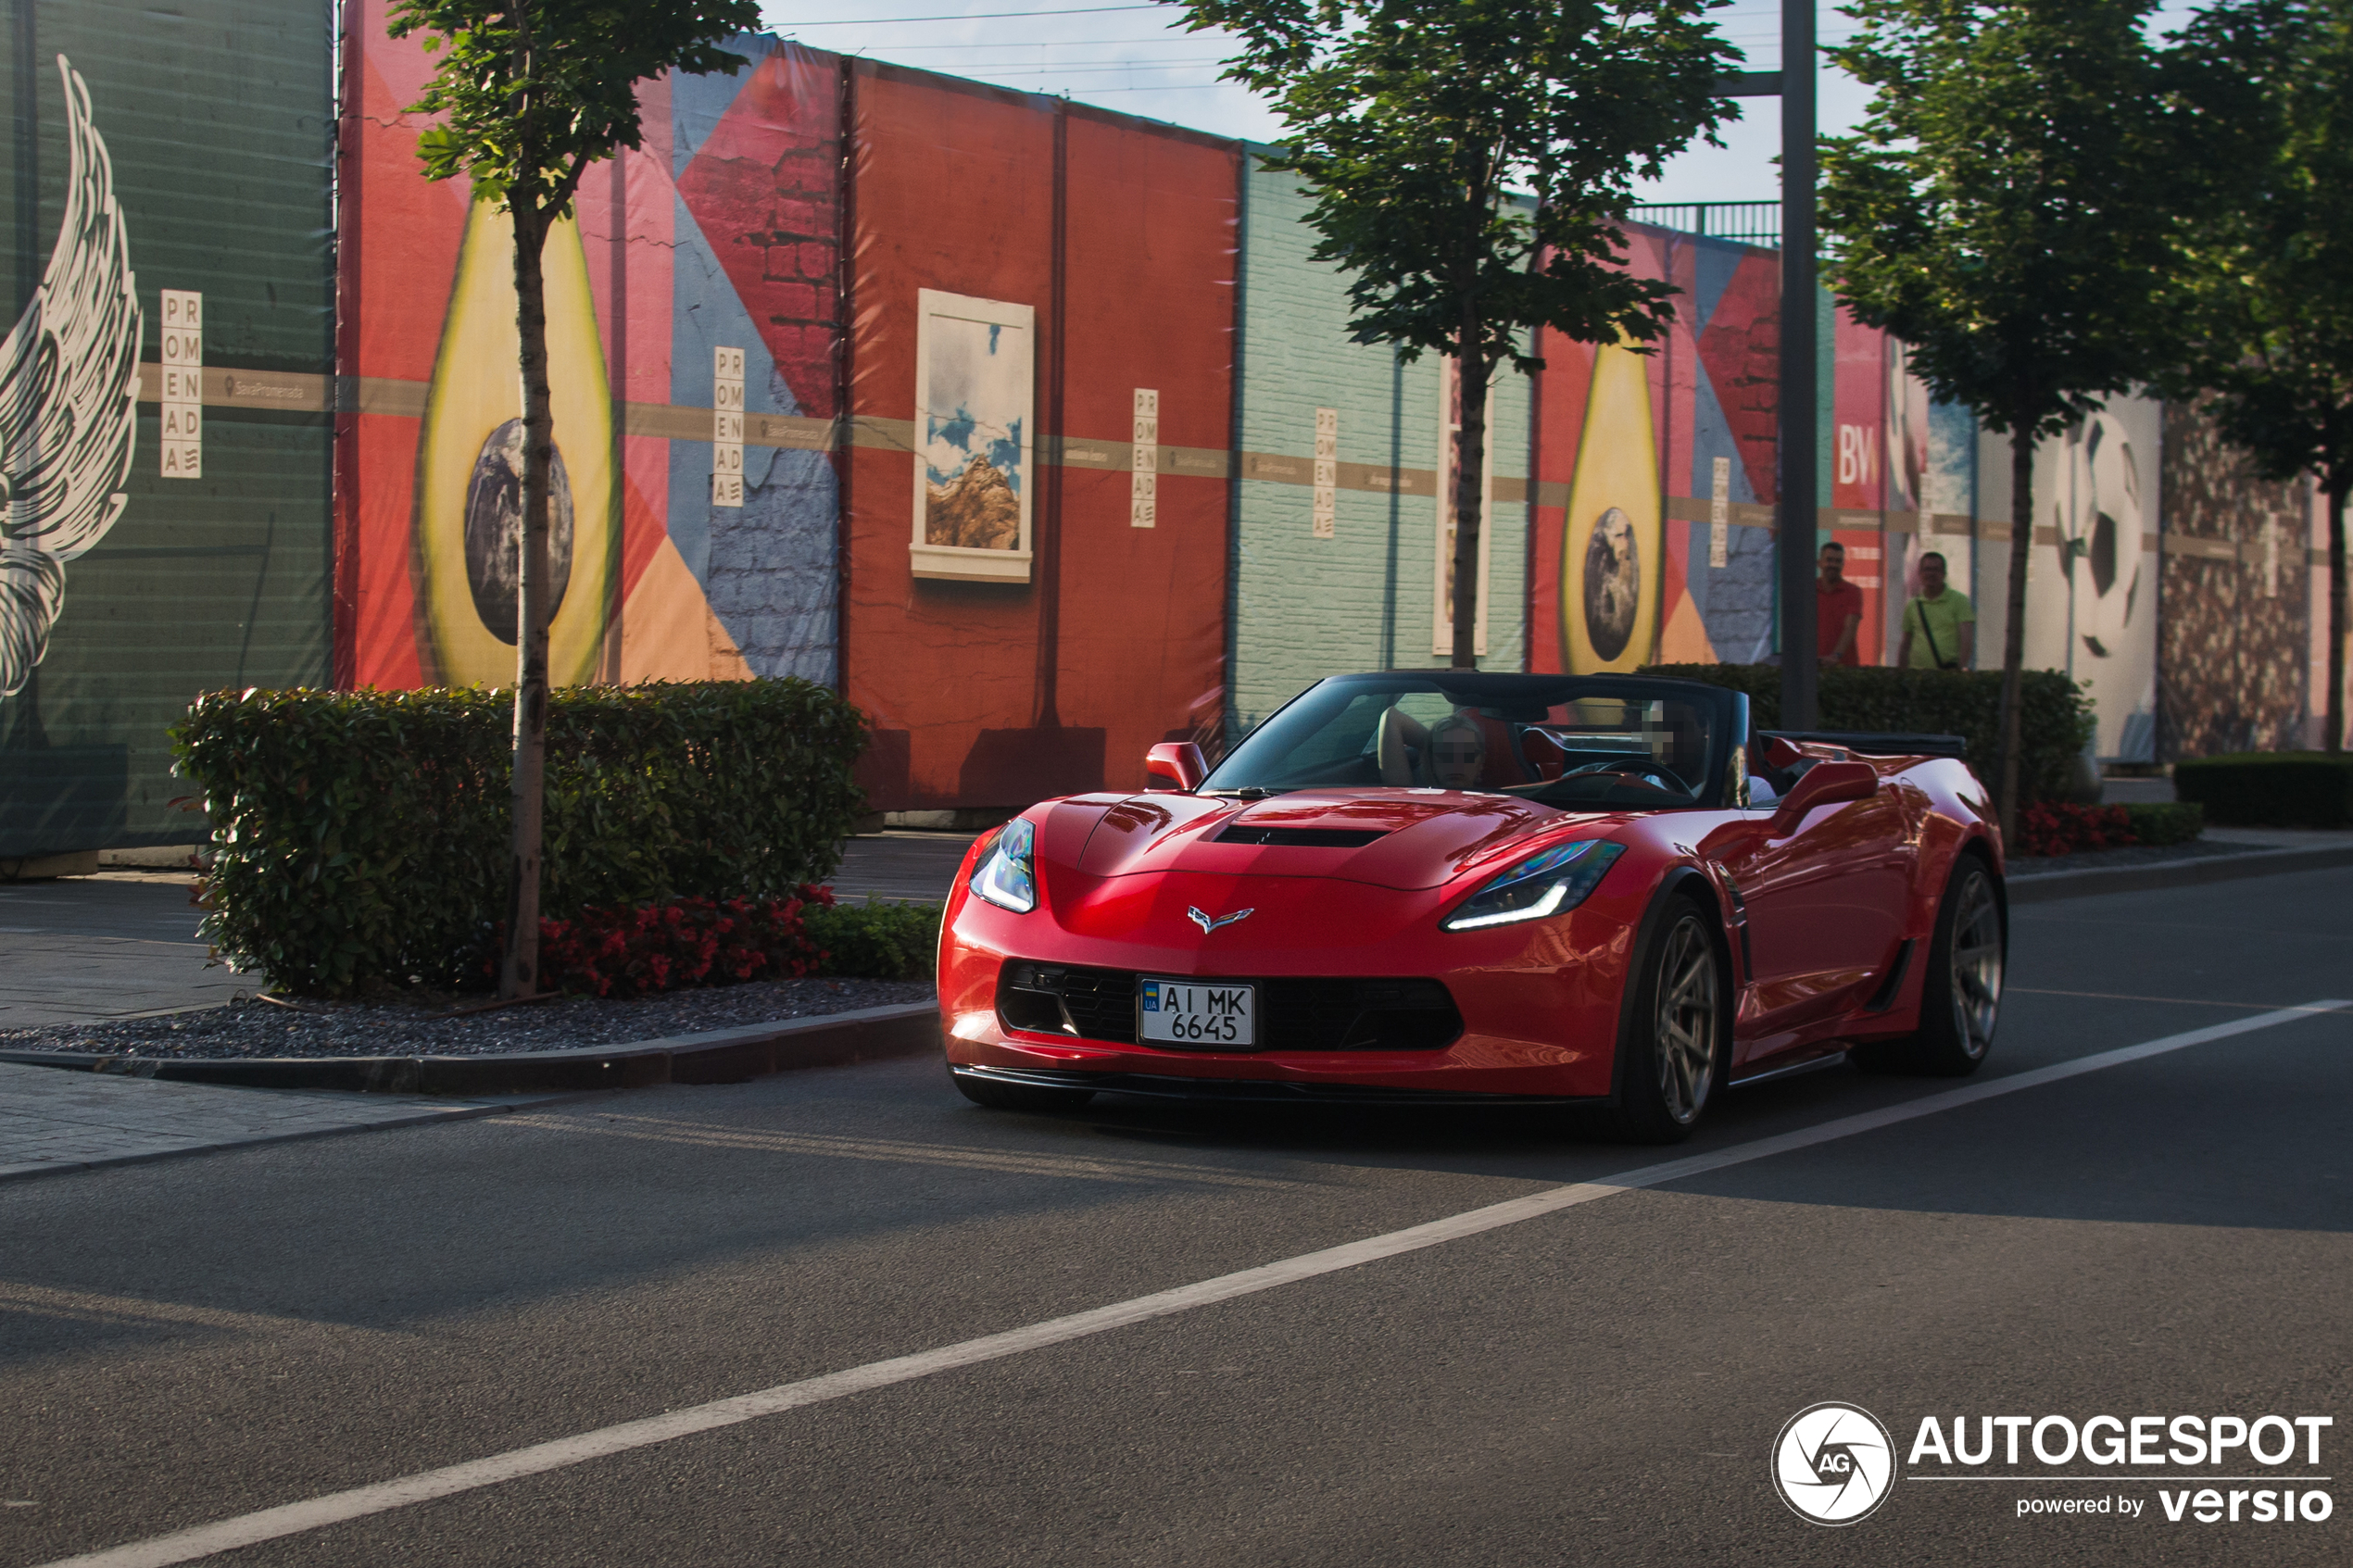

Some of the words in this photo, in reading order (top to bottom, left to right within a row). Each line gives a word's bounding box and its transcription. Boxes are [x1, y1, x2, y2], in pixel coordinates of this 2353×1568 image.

[1145, 1000, 1157, 1010] UA
[1207, 988, 1247, 1016] MK
[1172, 1013, 1238, 1041] 6645
